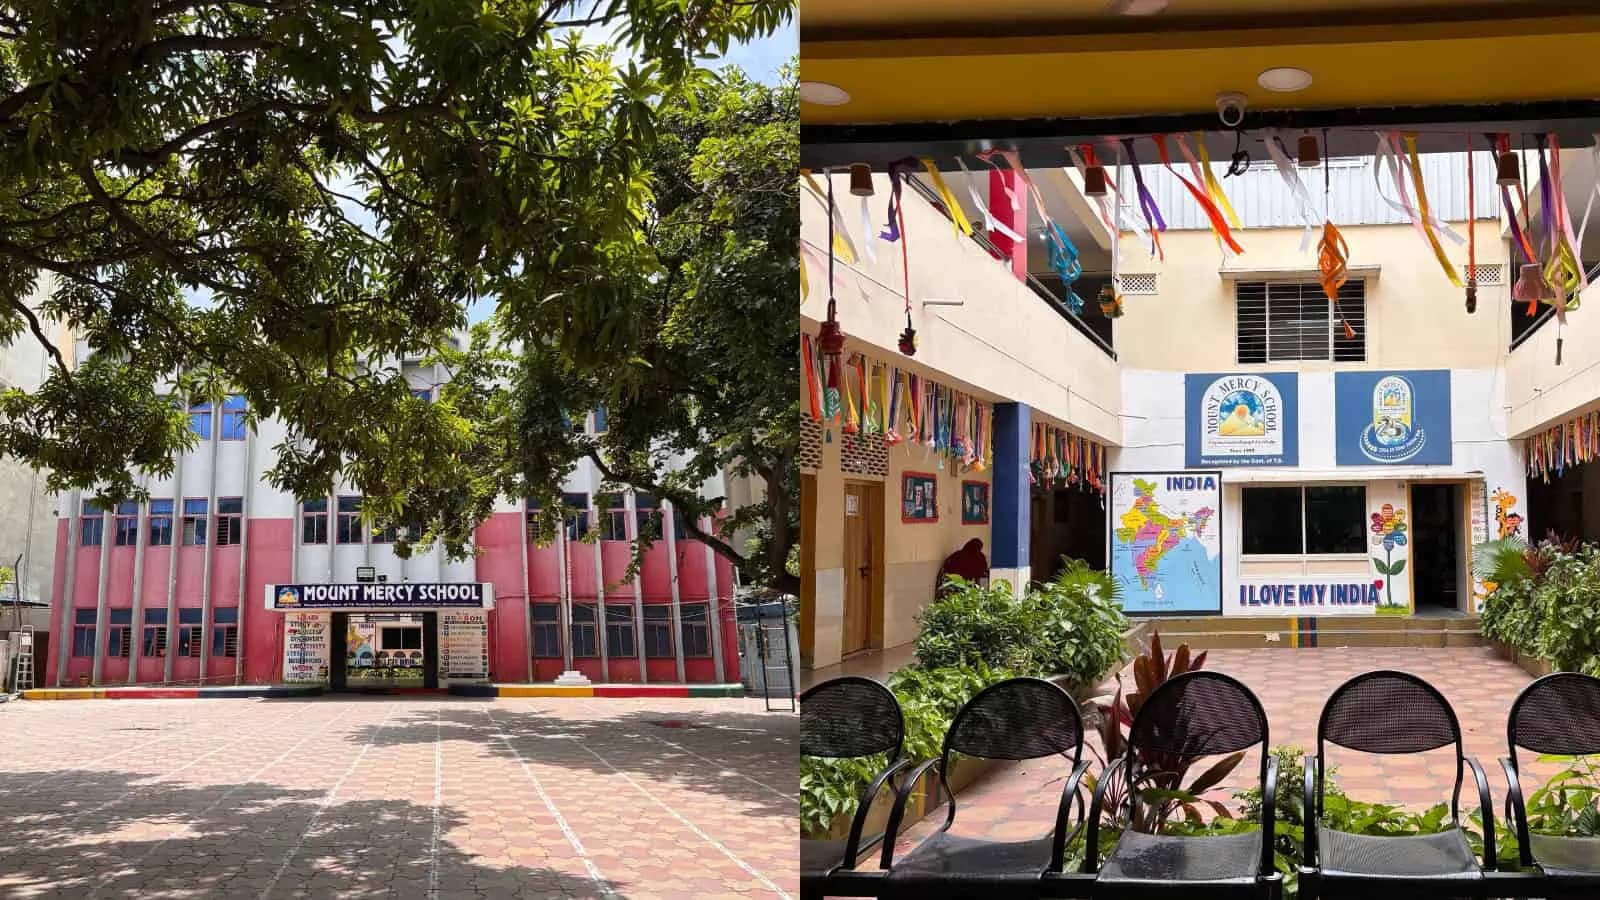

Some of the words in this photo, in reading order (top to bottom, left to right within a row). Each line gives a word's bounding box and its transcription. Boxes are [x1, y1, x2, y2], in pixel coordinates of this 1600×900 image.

[1208, 395, 1220, 434] MOUNT
[1219, 377, 1262, 395] MERCY
[1261, 389, 1277, 434] SCHOOL
[1166, 476, 1217, 491] INDIA
[303, 585, 360, 601] MOUNT
[363, 585, 415, 602] MERCY
[419, 585, 480, 602] SCHOOL
[1240, 585, 1247, 606] I
[1248, 585, 1296, 606] LOVE
[1298, 584, 1328, 606] MY
[1331, 583, 1380, 606] INDIA
